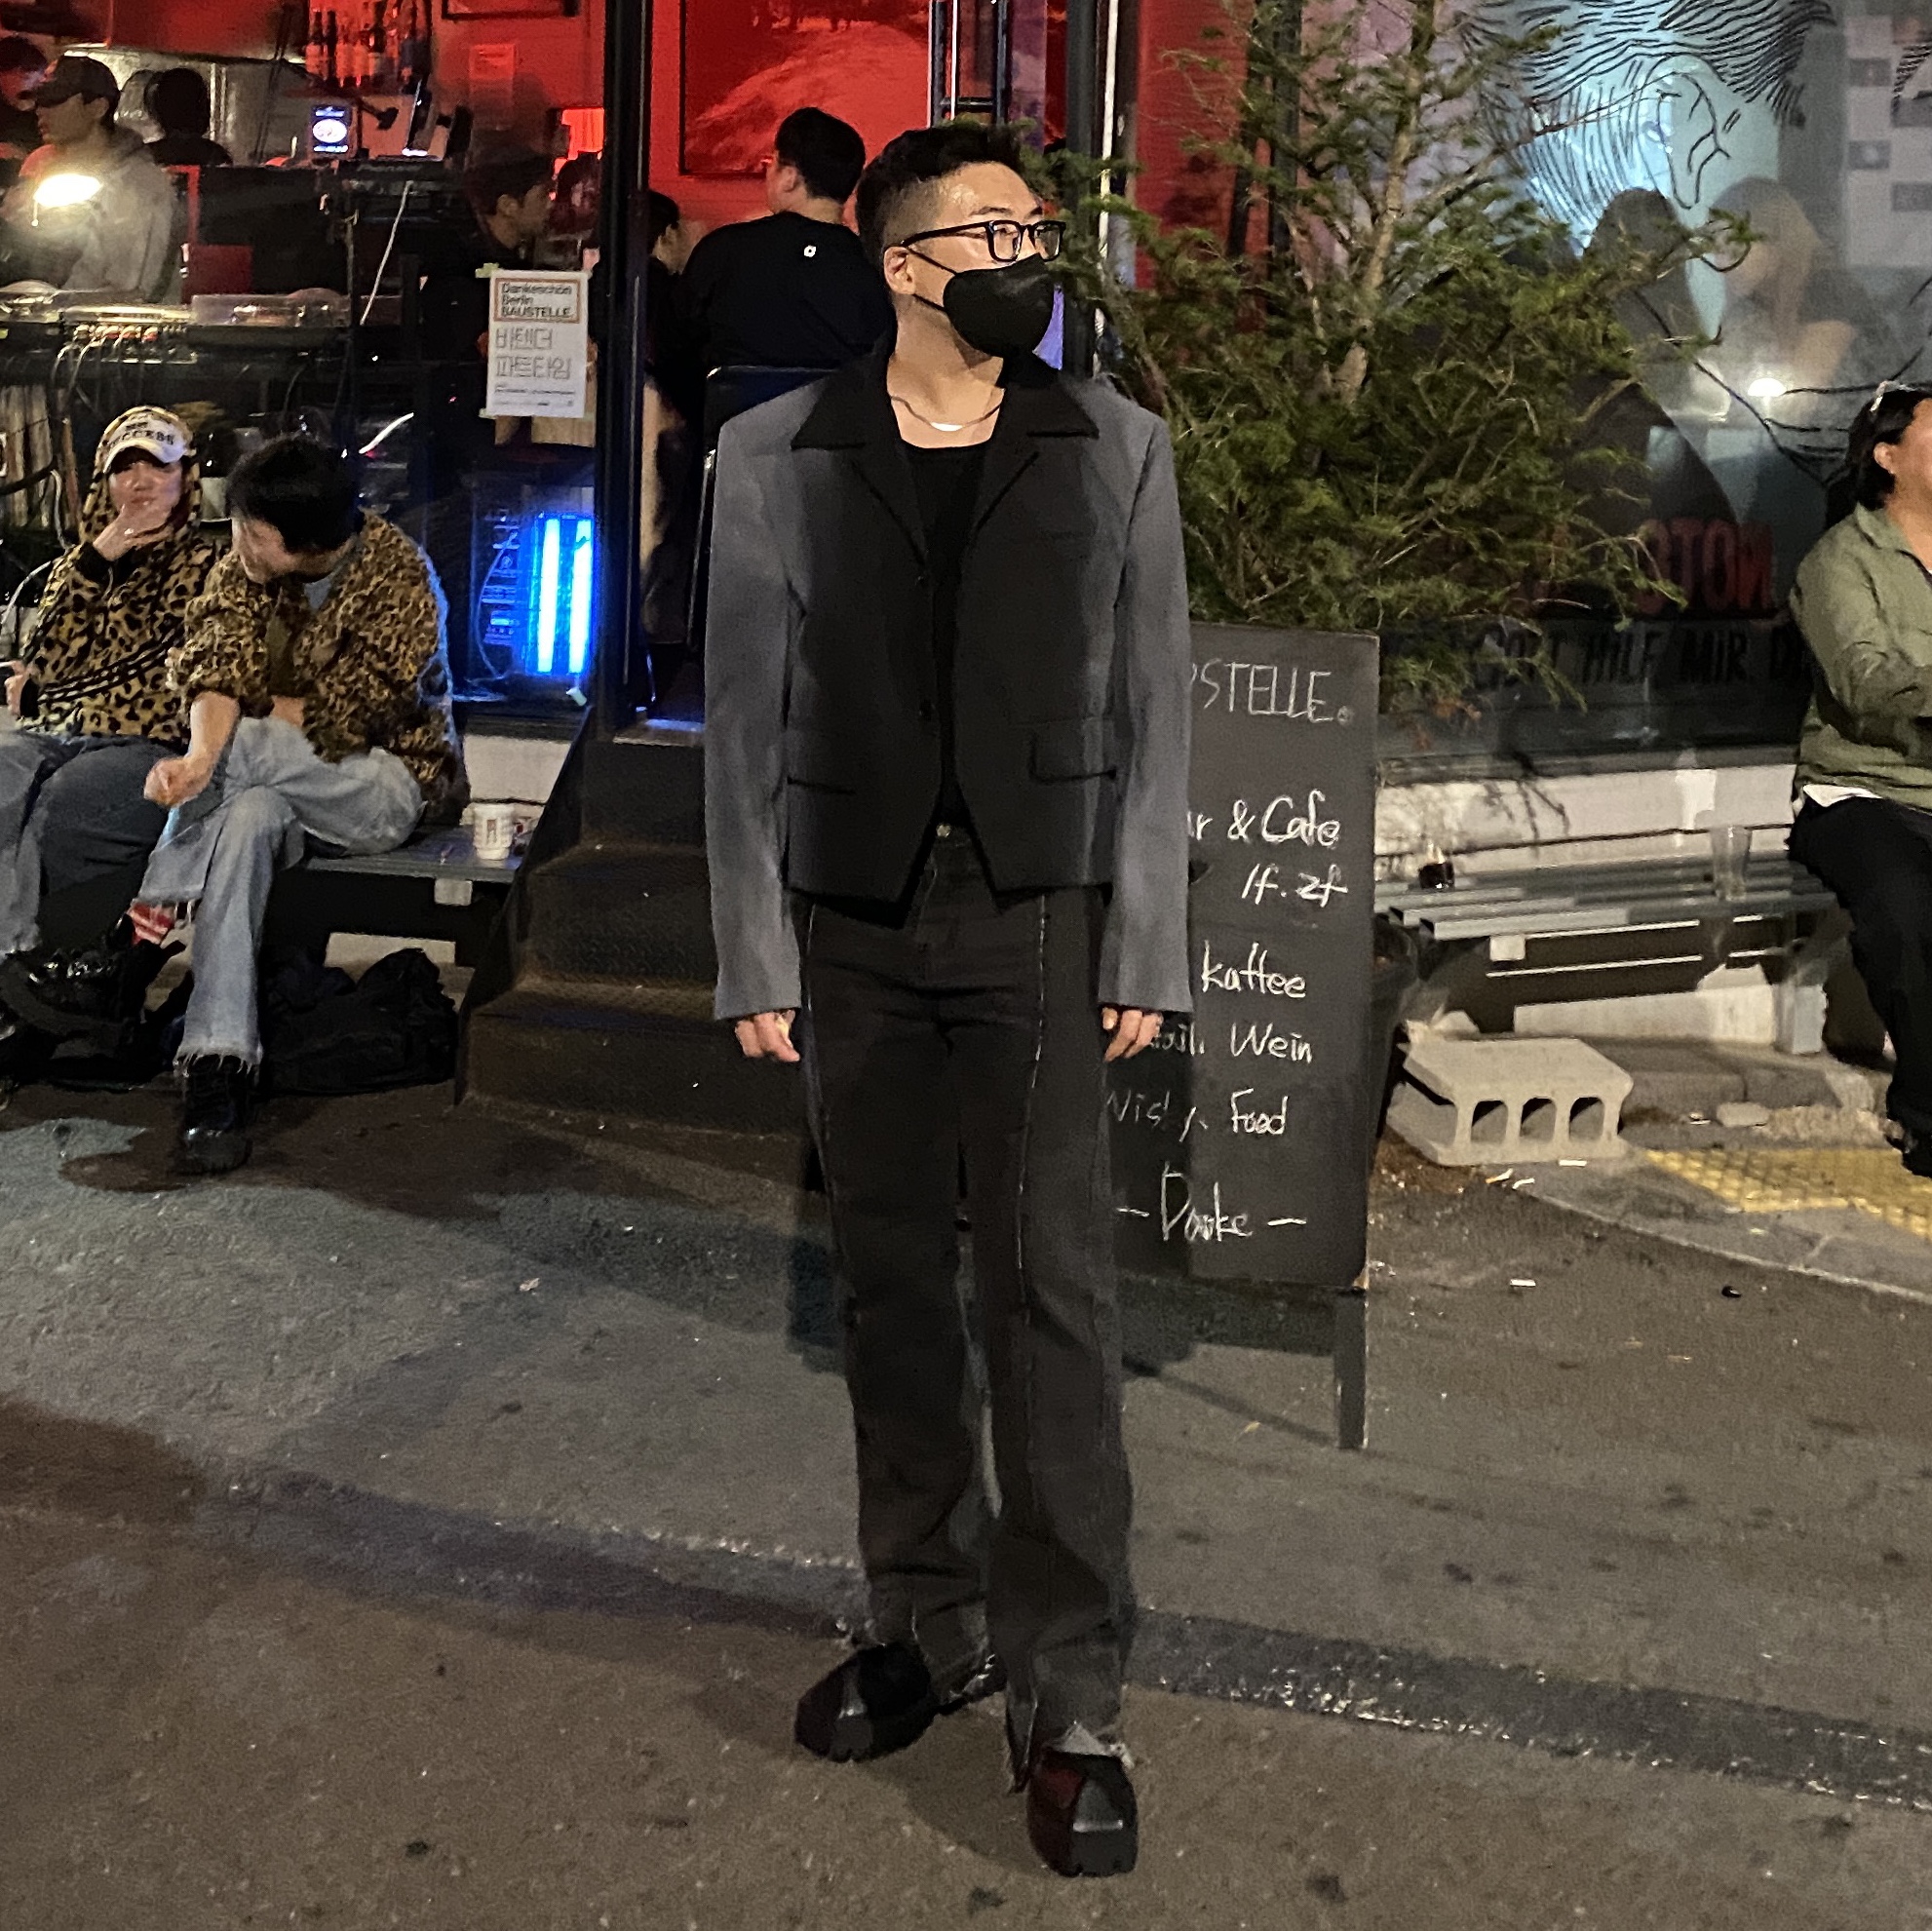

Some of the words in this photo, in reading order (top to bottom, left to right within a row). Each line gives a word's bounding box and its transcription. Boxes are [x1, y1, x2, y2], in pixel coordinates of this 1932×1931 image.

[495, 356, 571, 379] 파트타임
[1231, 1023, 1313, 1064] Wein
[1231, 1088, 1289, 1135] Food
